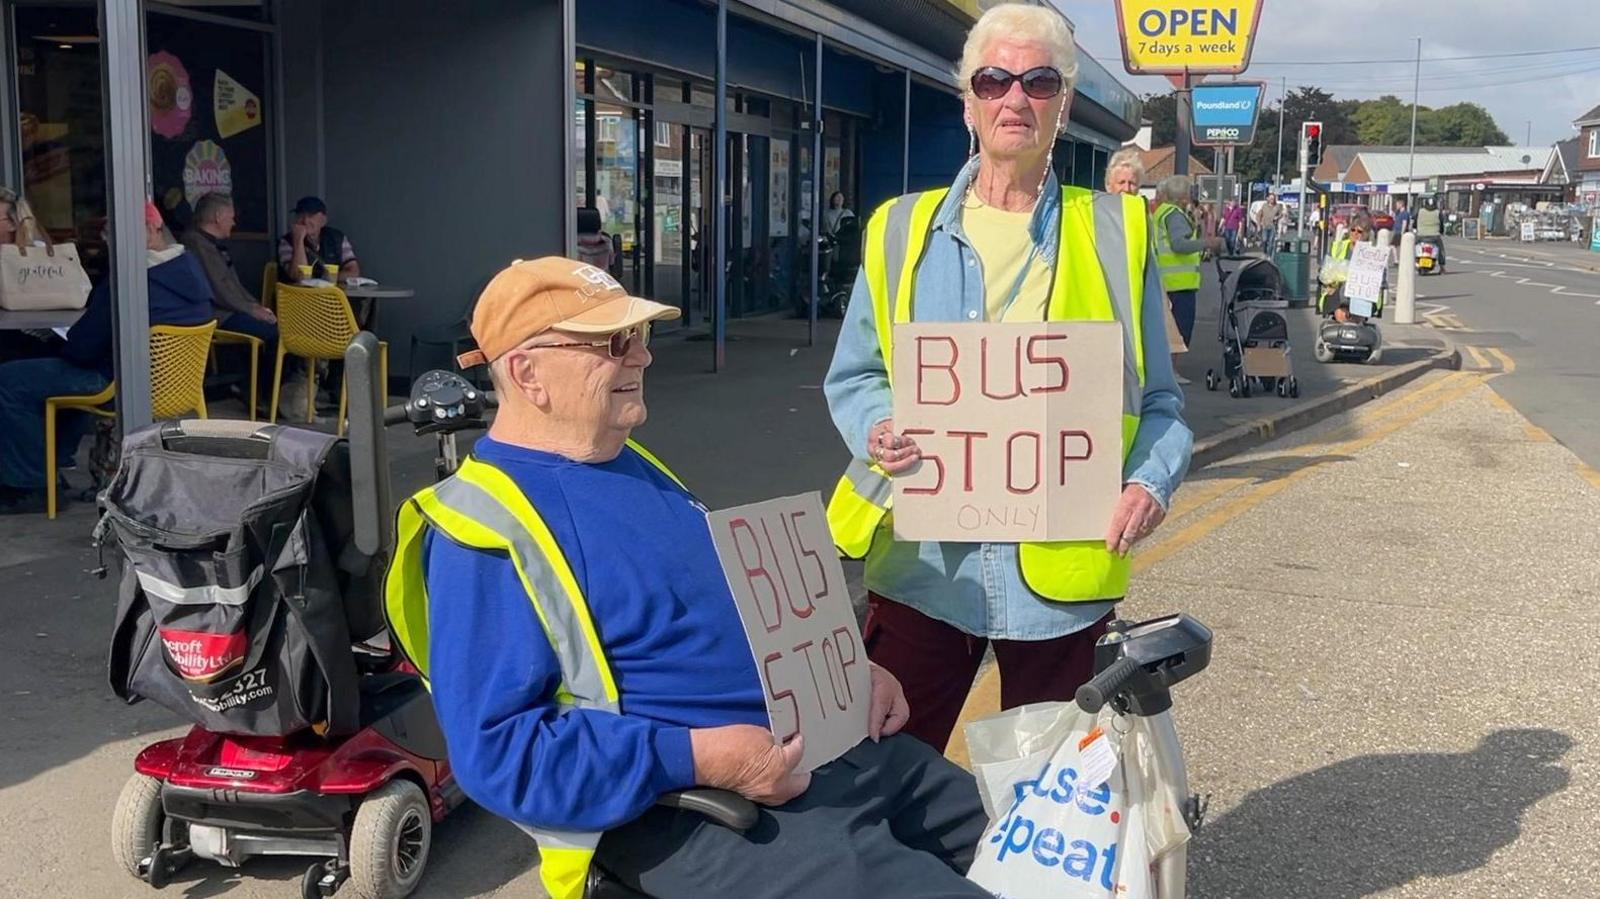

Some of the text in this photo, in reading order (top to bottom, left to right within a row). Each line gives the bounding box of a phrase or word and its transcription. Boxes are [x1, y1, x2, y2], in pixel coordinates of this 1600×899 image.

[1138, 8, 1238, 37] OPEN
[1138, 40, 1236, 57] 7 days a week
[1196, 101, 1240, 110] Poundland
[184, 168, 230, 184] BAKING
[17, 264, 64, 285] grateful
[914, 335, 1069, 406] BUS
[901, 428, 1094, 496] STOP
[957, 504, 1041, 533] ONLY
[729, 510, 829, 633] BUS
[163, 639, 203, 652] croft
[764, 626, 857, 745] STOP
